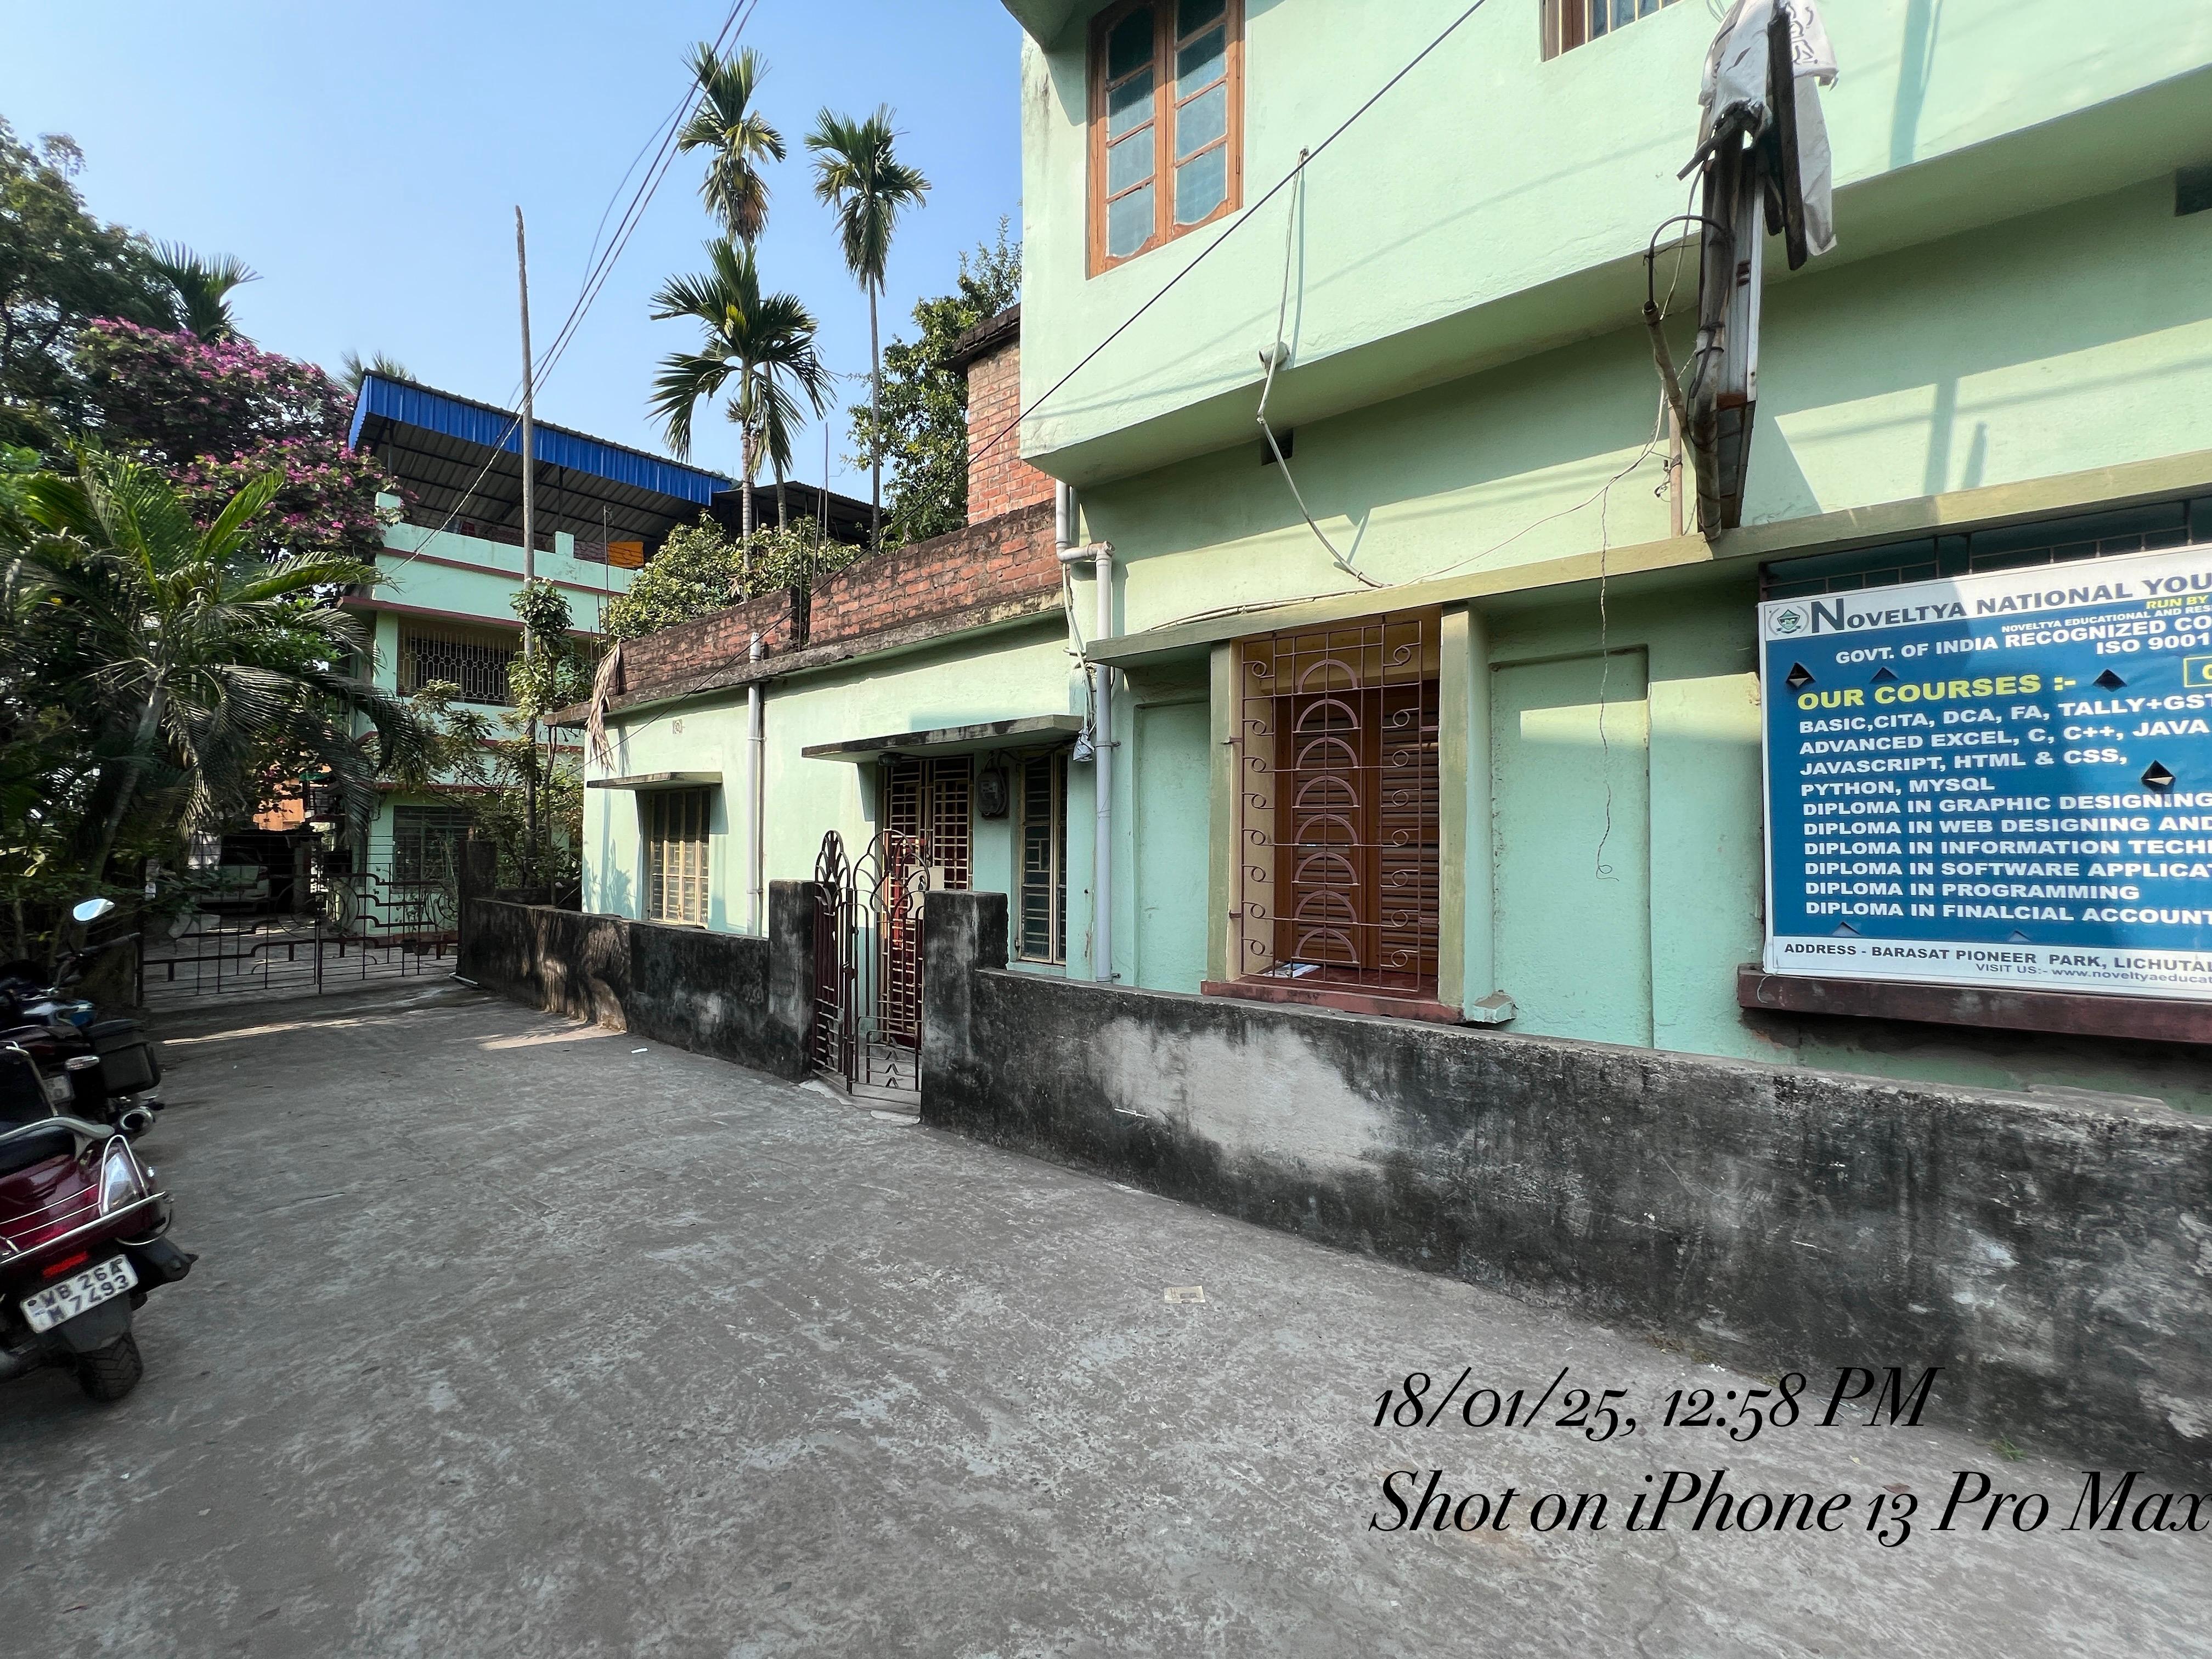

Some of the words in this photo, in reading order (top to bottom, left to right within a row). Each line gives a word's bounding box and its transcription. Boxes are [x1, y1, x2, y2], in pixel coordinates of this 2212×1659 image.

[1977, 583, 2133, 615] NATIONAL
[2142, 572, 2212, 595] YOU
[2146, 597, 2182, 610] RUN
[2186, 595, 2209, 606] BY
[2001, 620, 2062, 633] NOVELTYA
[2065, 611, 2151, 627] EDUCATIONAL
[2154, 608, 2182, 617] AND
[1836, 646, 1894, 664] GOVT.
[1900, 643, 1929, 658] OF
[1936, 636, 1999, 654] INDIA
[2005, 619, 2166, 648] RECOGNIZED
[2174, 614, 2212, 632] CO
[2096, 639, 2140, 655] ISO
[2147, 632, 2210, 650] 9001
[1797, 689, 1865, 710] OUR
[1874, 674, 2041, 705] COURSES
[1943, 708, 2002, 725] DCA,
[2011, 705, 2050, 721] FA,
[1799, 735, 1923, 755] ADVANCED
[1931, 731, 2019, 747] EXCEL,
[2027, 728, 2055, 743] C,
[2063, 725, 2124, 741] C++,
[2132, 719, 2210, 737] JAVA
[1799, 756, 1945, 776] JAVASCRIPT,
[1954, 753, 2027, 769] HTML
[2034, 751, 2055, 766] &
[2063, 748, 2128, 765] CSS,
[1801, 781, 1901, 797] PYTHON,
[1909, 777, 1995, 792] MYSQL
[1803, 801, 1901, 816] DIPLOMA
[1908, 800, 1932, 813] IN
[1939, 797, 2051, 812] GRAPHIC
[2059, 792, 2212, 810] DESIGNING
[1803, 822, 1901, 836] DIPLOMA
[1909, 821, 1932, 834] IN
[1939, 819, 1993, 833] WEB
[2001, 817, 2150, 833] DESIGNING
[2158, 816, 2212, 831] AND
[1804, 842, 1902, 855] DIPLOMA
[1909, 842, 1933, 854] IN
[1940, 840, 2119, 855] INFORMATION
[2128, 840, 2212, 854] TECH
[1804, 862, 1903, 876] DIPLOMA
[1909, 862, 1934, 875] IN
[1941, 862, 2080, 877] SOFTWARE
[2087, 863, 2212, 878] APPLICA
[1805, 882, 1903, 896] DIPLOMA
[1910, 883, 1934, 896] IN
[1942, 883, 2139, 900] PROGRAMMING
[1805, 902, 1904, 916] DIPLOMA
[1910, 904, 1935, 917] IN
[1943, 904, 2074, 921] FINALCIAL
[1784, 944, 1857, 955] ADDRESS
[1872, 946, 1950, 960] BARASAT
[1956, 950, 2037, 964] PIONEER
[2049, 954, 2107, 969] PARK,
[1976, 963, 2011, 973] VISIT
